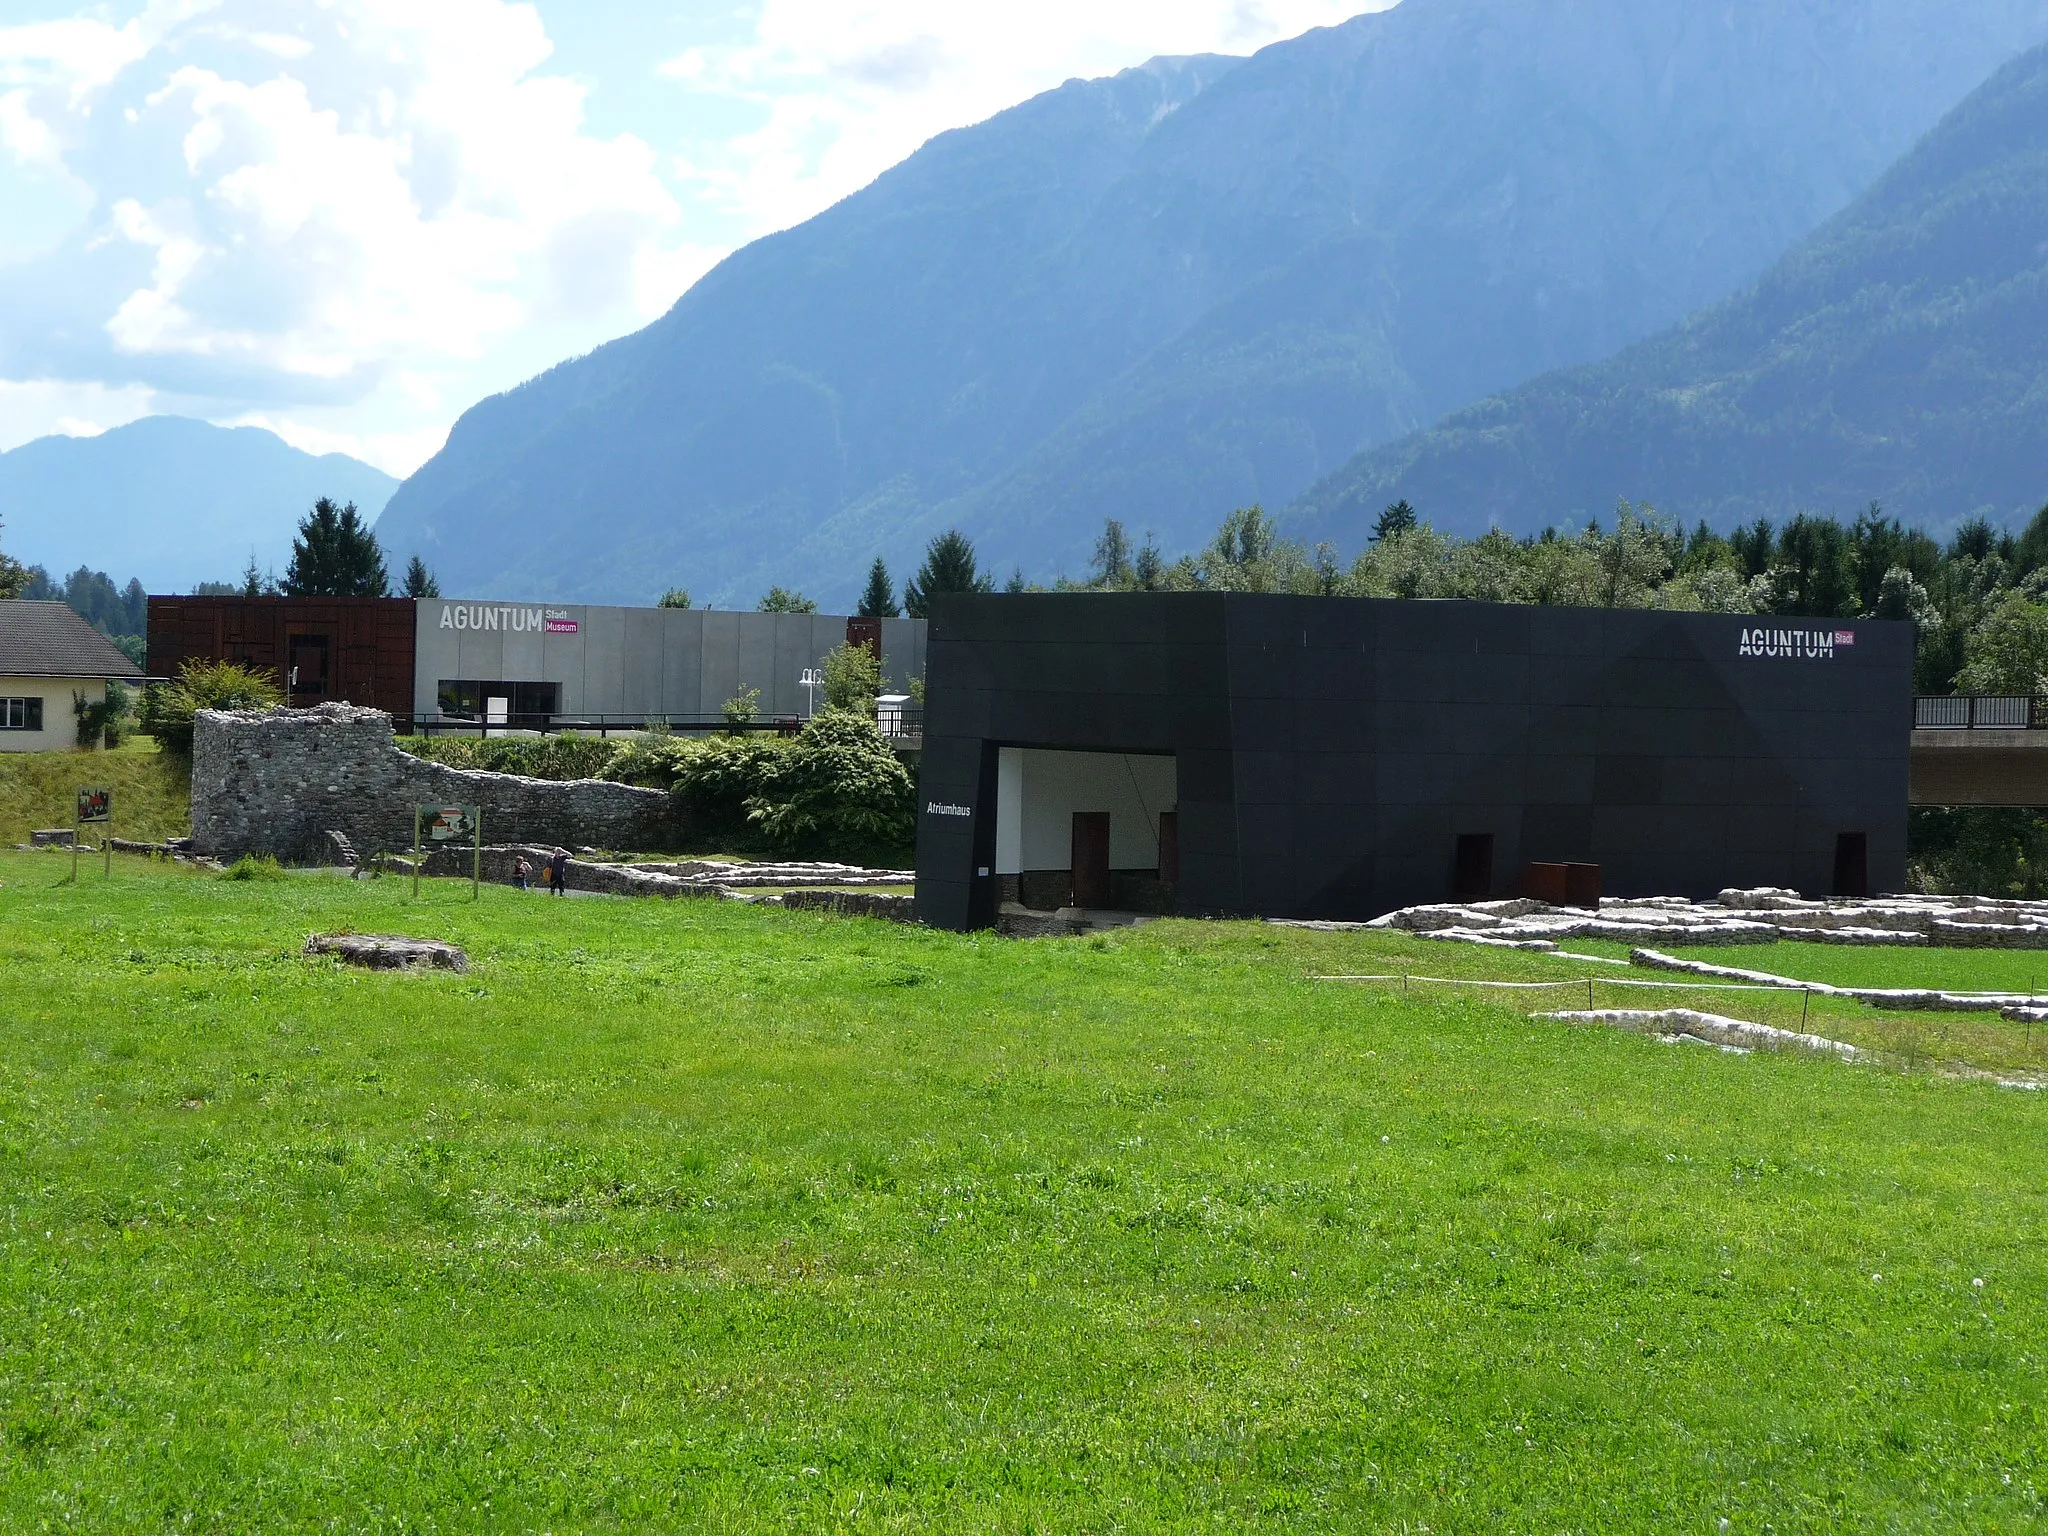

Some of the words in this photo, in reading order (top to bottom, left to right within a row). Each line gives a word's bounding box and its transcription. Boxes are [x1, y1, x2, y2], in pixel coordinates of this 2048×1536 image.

[440, 605, 542, 632] AGUNTUM
[545, 609, 567, 619] Stadt
[546, 622, 577, 632] Museum
[1739, 629, 1833, 658] AGUNTUM
[1835, 632, 1853, 644] Stadt
[927, 802, 971, 816] Atriumhaus
